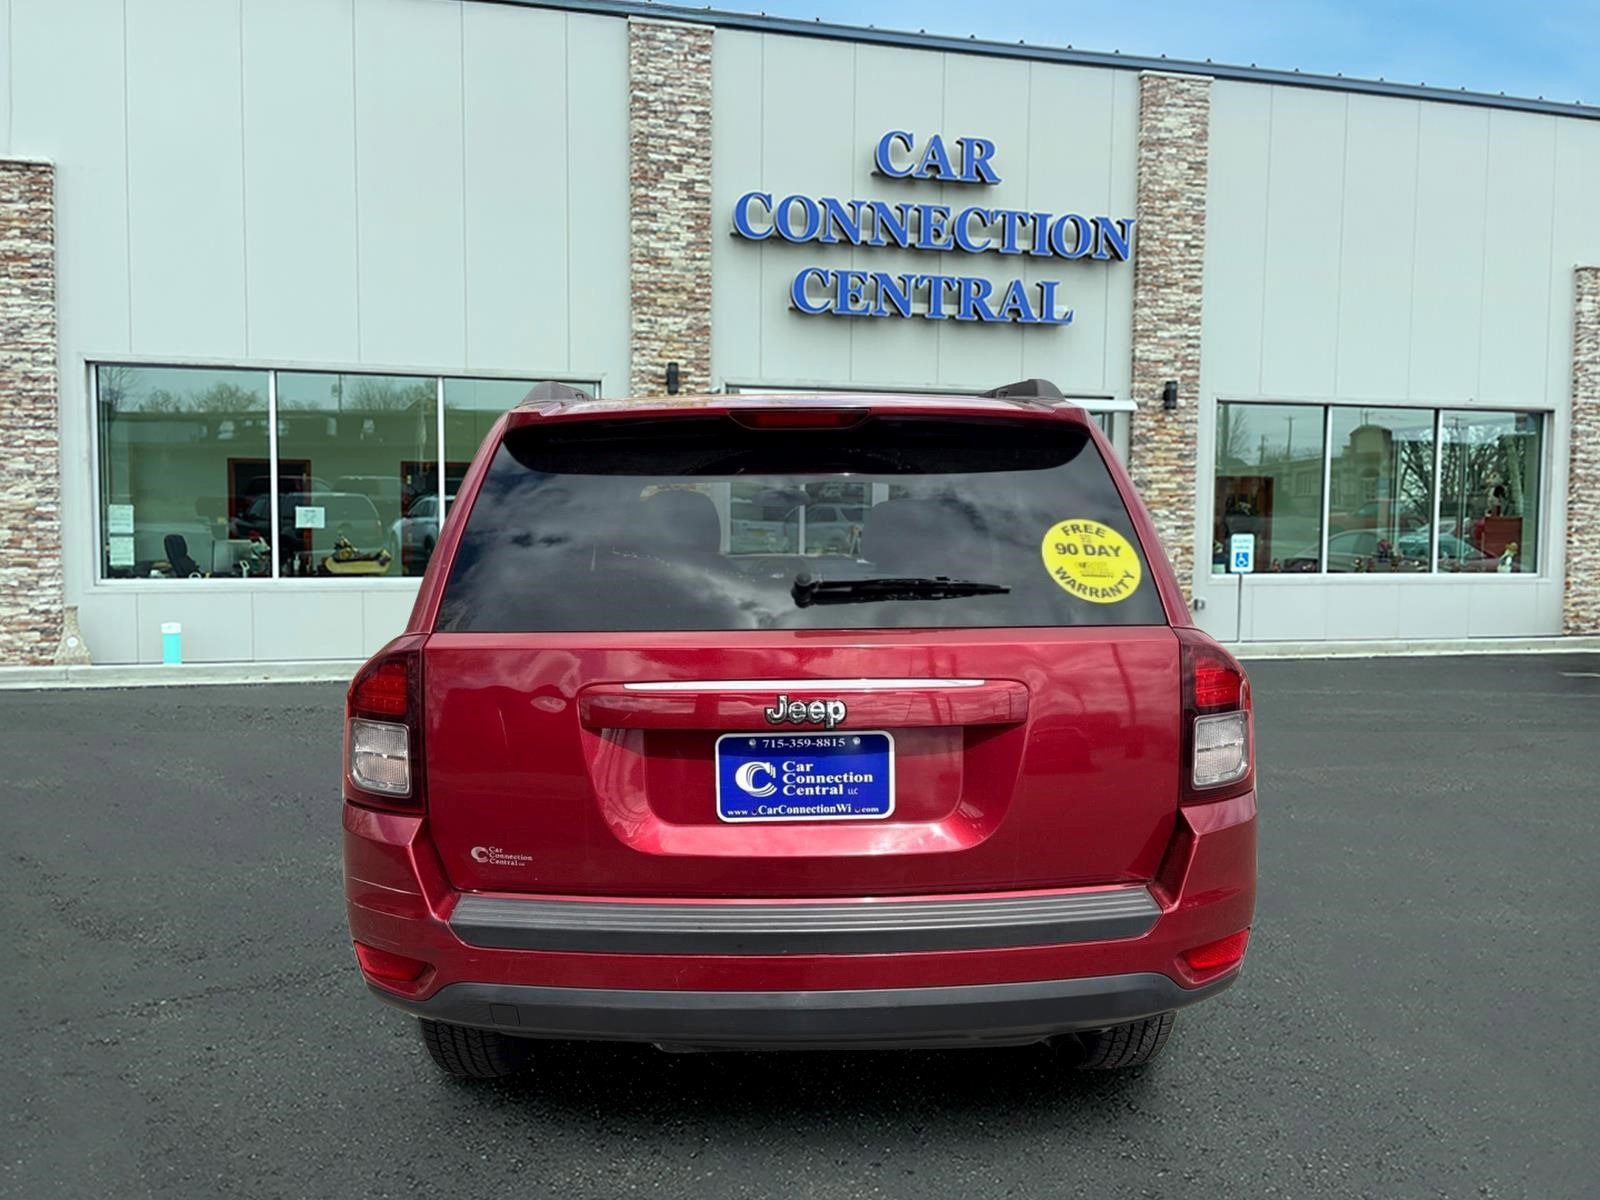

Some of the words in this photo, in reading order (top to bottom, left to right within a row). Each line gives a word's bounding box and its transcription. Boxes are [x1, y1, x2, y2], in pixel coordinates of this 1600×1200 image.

[875, 130, 1001, 185] CAR
[732, 191, 1135, 262] CONNECTION
[790, 267, 1074, 325] CENTRAL
[1061, 523, 1107, 538] FREE
[1054, 542, 1079, 556] 90
[1083, 543, 1122, 557] DAY
[1054, 565, 1135, 599] WARRANTY
[764, 694, 848, 729] Jeep
[762, 737, 846, 749] 715-359-8815
[782, 760, 814, 773] Car
[782, 771, 873, 784] Connection
[782, 783, 844, 796] Central
[488, 846, 504, 854] Car
[489, 852, 534, 861] Connection
[489, 858, 518, 866] Central
